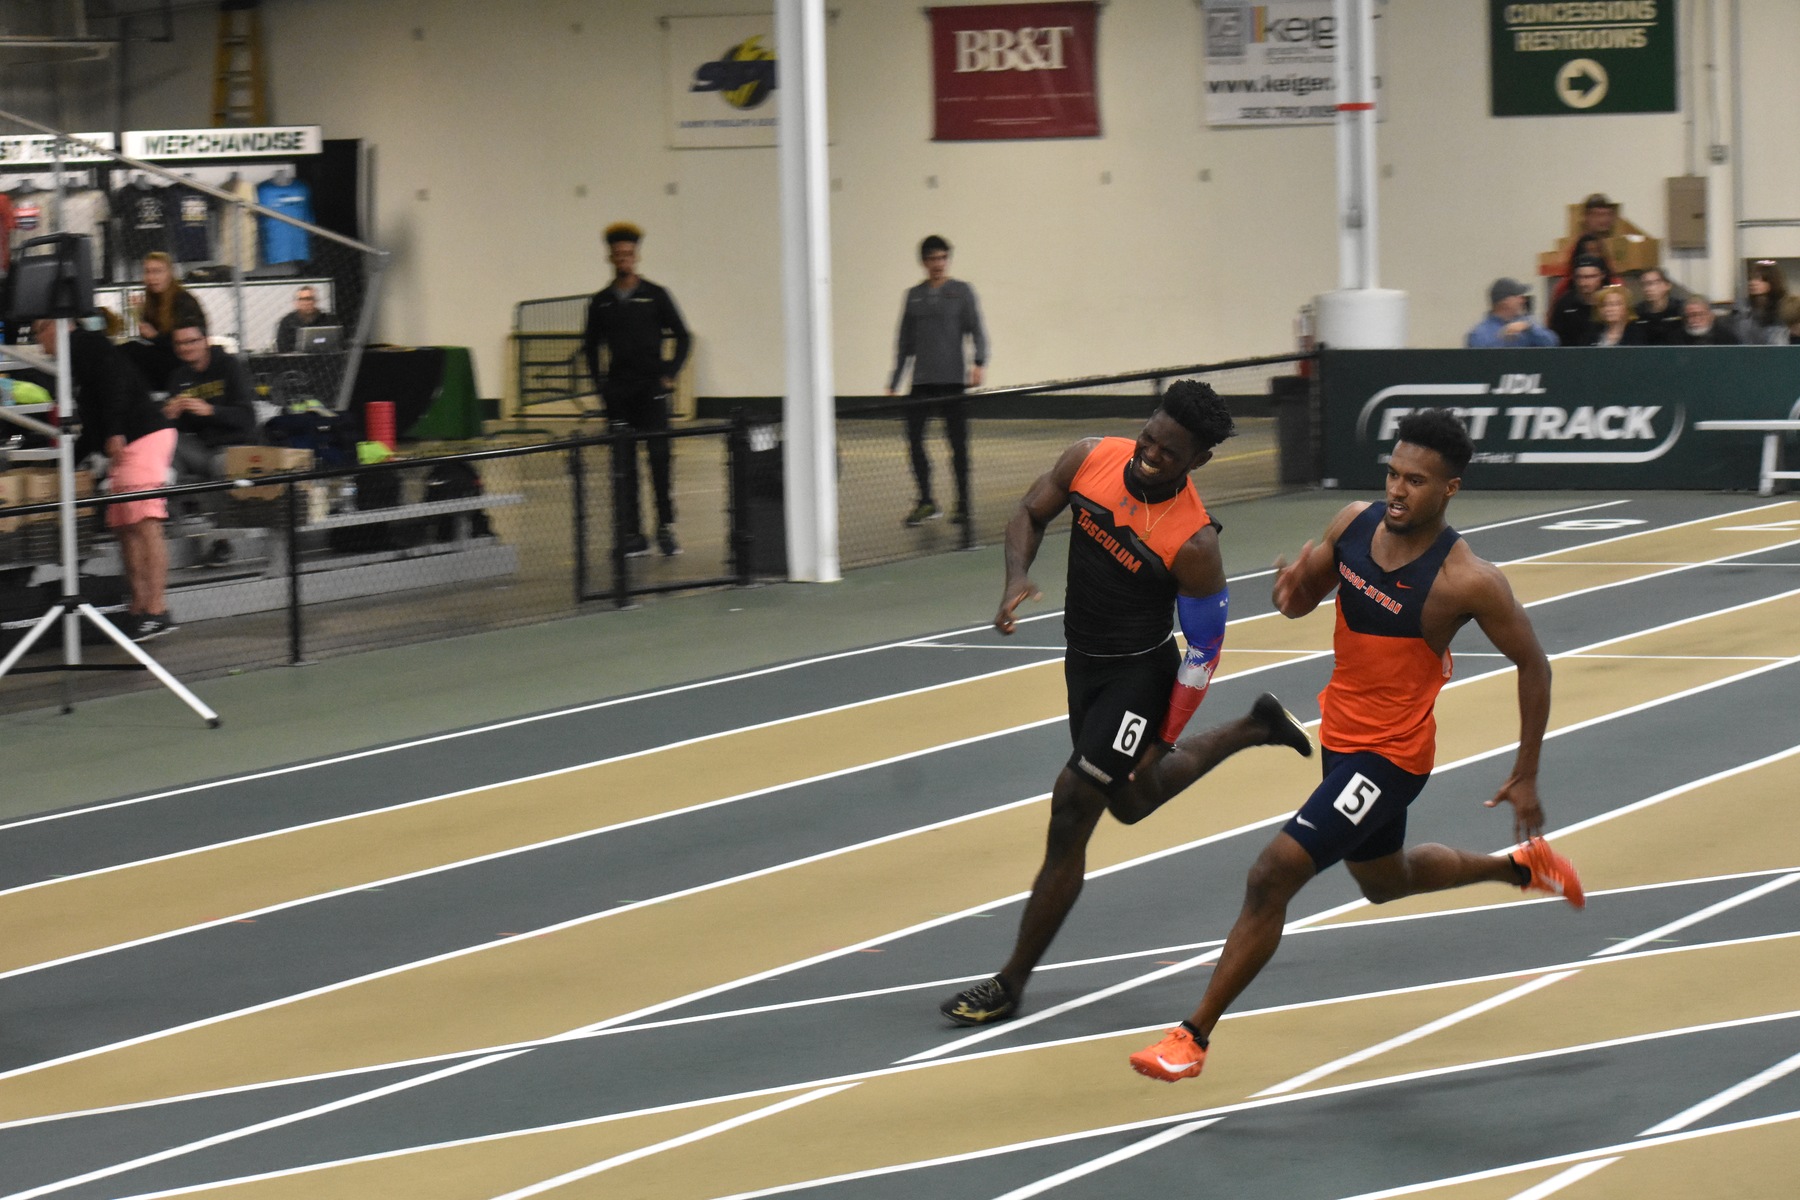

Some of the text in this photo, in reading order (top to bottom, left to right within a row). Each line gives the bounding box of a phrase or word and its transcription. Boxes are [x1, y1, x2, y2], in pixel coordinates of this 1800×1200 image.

[1256, 8, 1341, 49] keig
[1504, 0, 1658, 24] CONCESSIONS
[952, 26, 1074, 73] BB&T
[1514, 28, 1648, 51] RESTROOMS
[1203, 75, 1382, 95] www.keiger.
[143, 131, 307, 155] MERCHANDISE
[1492, 373, 1547, 394] JDL
[1377, 405, 1662, 440] FT TRACK
[1077, 507, 1143, 574] TUSCULUM
[1121, 717, 1142, 752] 6
[1342, 780, 1375, 816] 5
